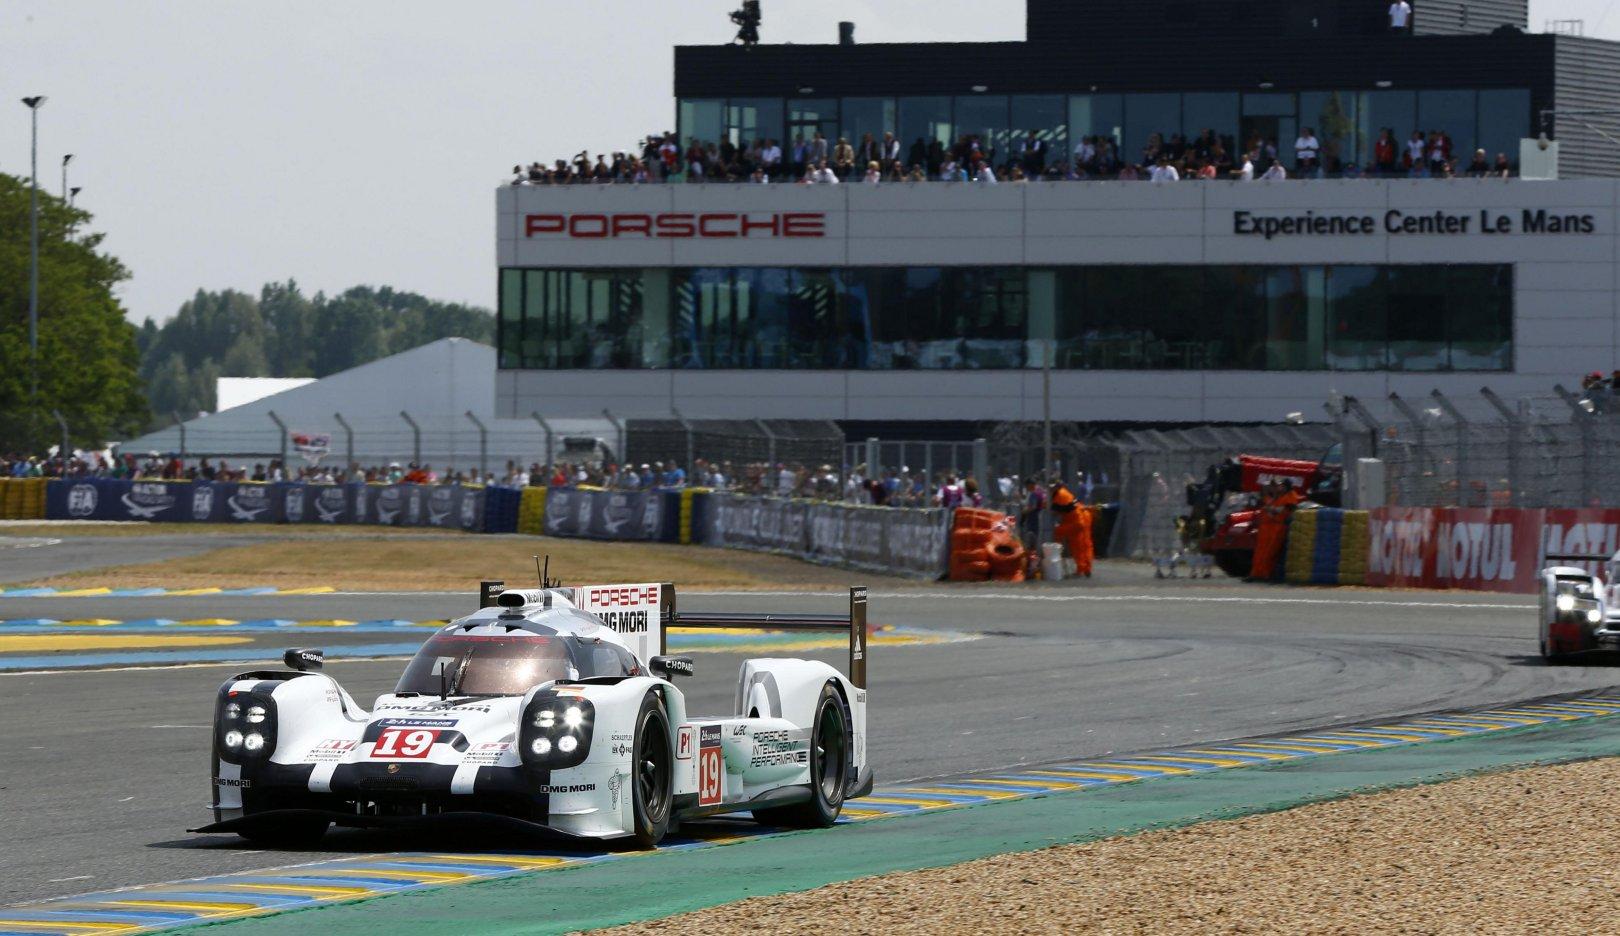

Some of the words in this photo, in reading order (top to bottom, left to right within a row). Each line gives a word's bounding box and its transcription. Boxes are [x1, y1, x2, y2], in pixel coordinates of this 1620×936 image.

[525, 213, 826, 238] PORSCHE
[1234, 211, 1376, 240] Experience
[1384, 209, 1471, 233] Center
[1480, 210, 1512, 233] Le
[1522, 209, 1595, 233] Mans
[1437, 521, 1517, 580] MOTUL
[591, 587, 658, 607] PORSCHE
[619, 610, 648, 633] MORI
[665, 660, 694, 672] CHOPARD
[374, 730, 434, 756] 19
[680, 733, 690, 754] P1
[753, 730, 788, 743] PORSCHE
[752, 741, 798, 756] INTELLIGENT
[750, 751, 807, 768] PERFORMANCE
[227, 779, 250, 788] MORI
[701, 752, 719, 799] 19
[541, 785, 567, 793] DMG
[569, 784, 596, 793] MORI
